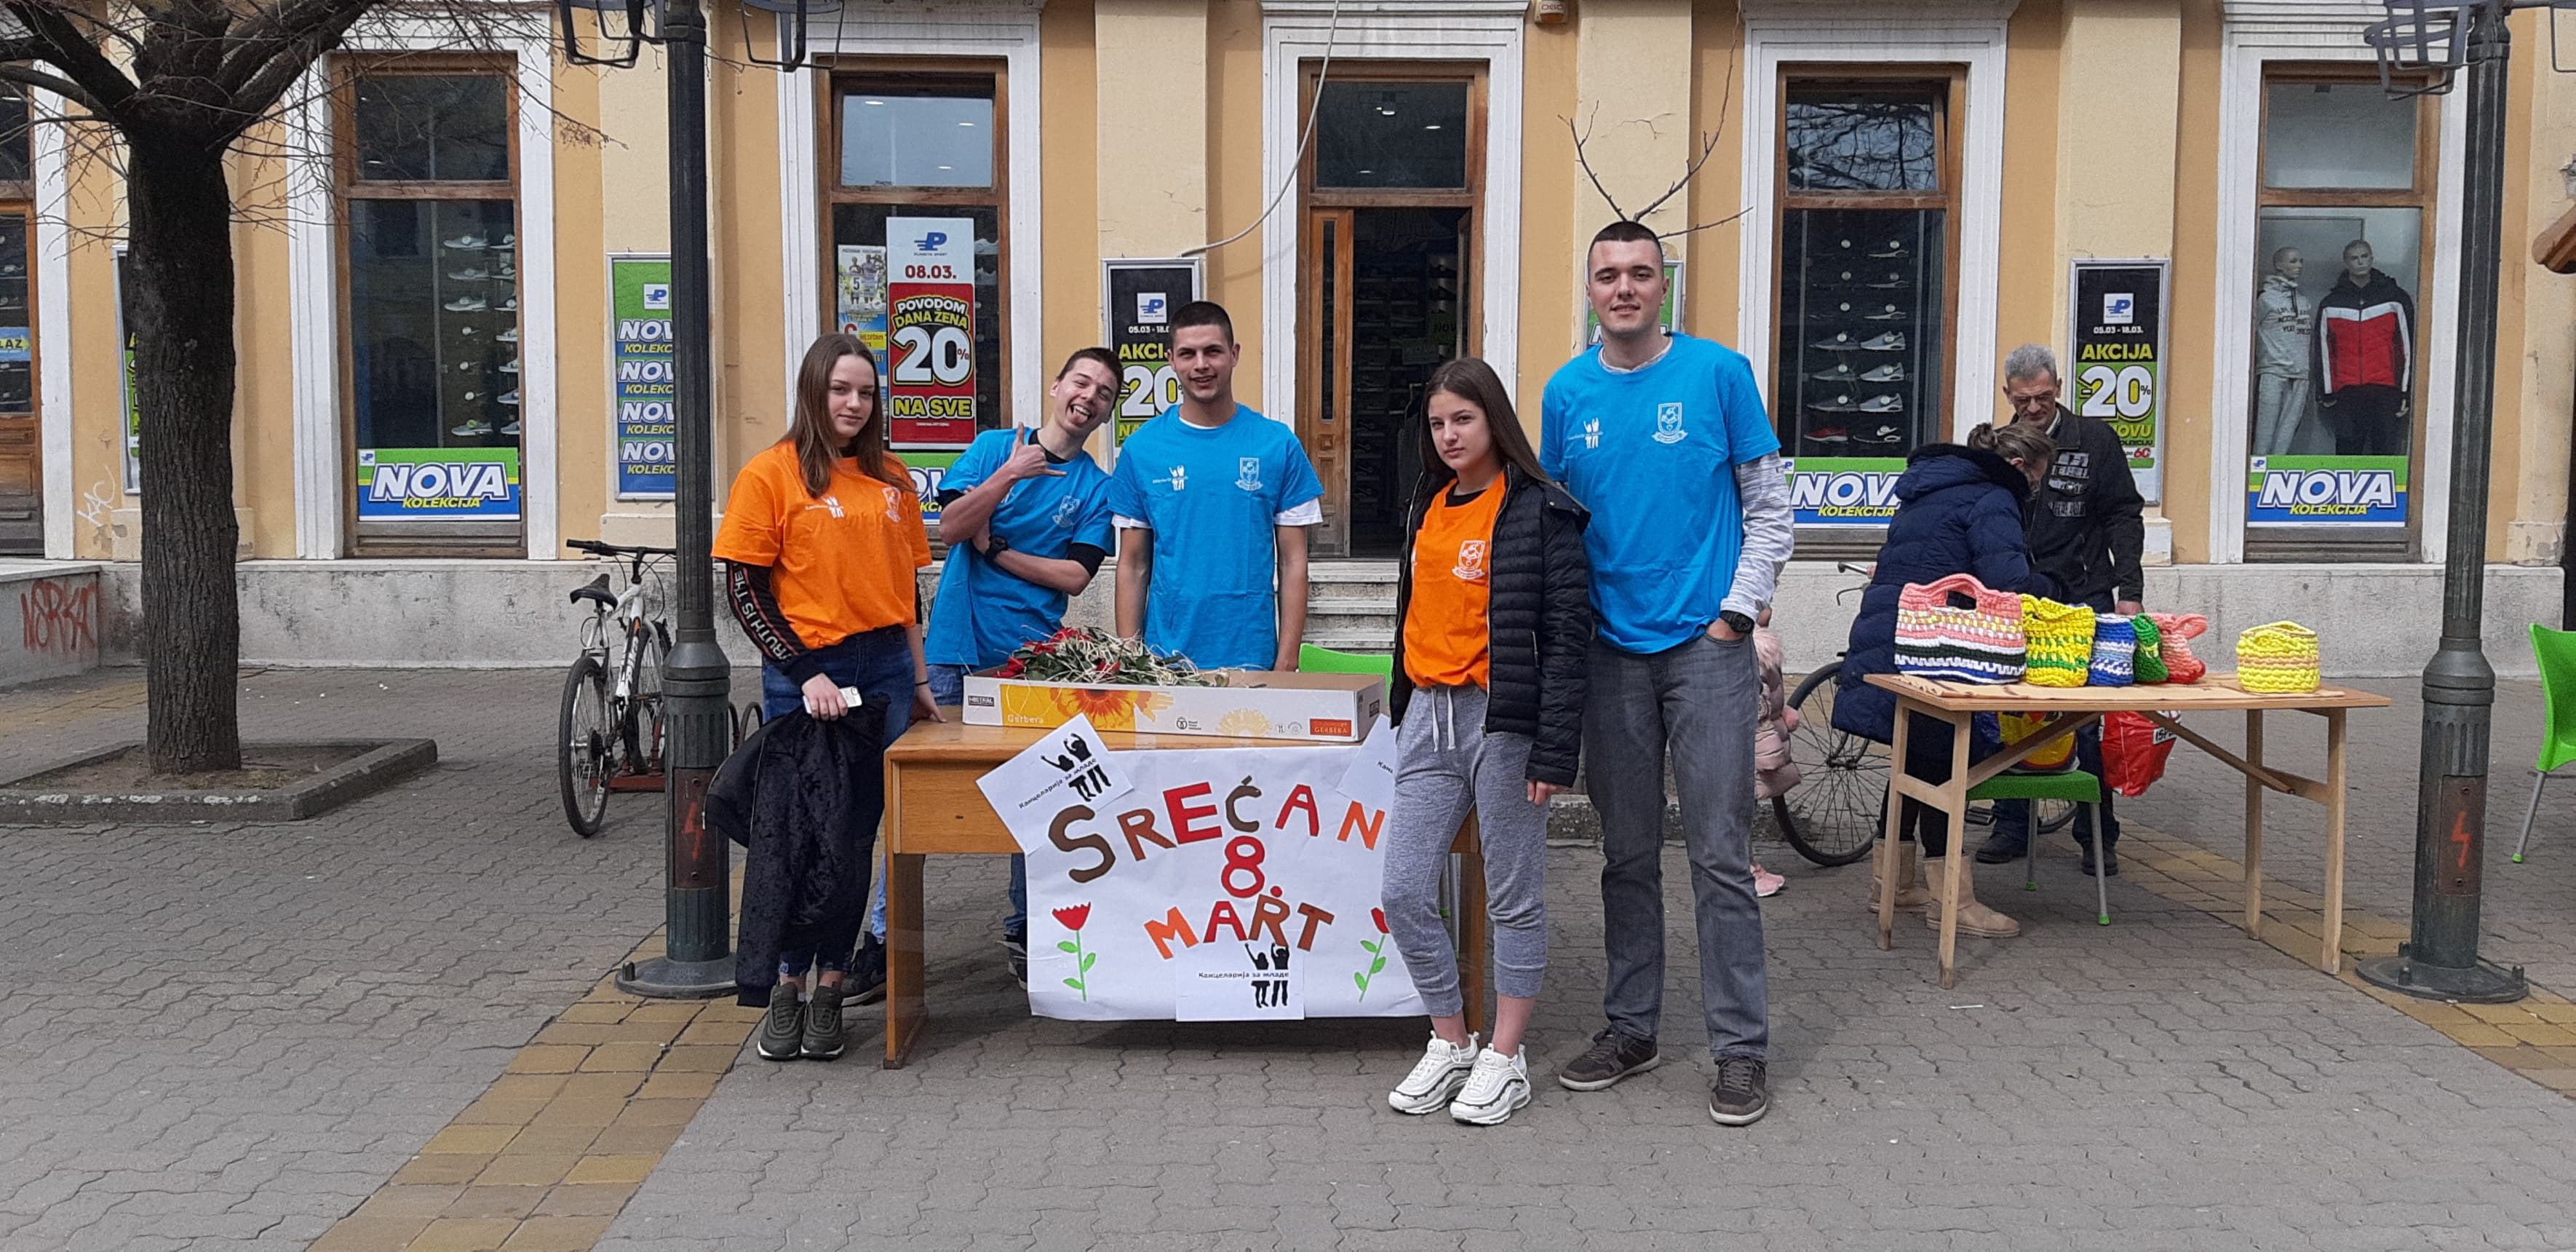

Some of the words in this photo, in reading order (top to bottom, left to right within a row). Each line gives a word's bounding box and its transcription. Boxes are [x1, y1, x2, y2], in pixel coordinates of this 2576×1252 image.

[905, 264, 957, 279] 08.03.
[897, 298, 967, 314] POVODOM
[894, 310, 932, 329] DANA
[934, 308, 968, 330] ŽENA
[1432, 322, 1456, 333] NOV
[619, 320, 673, 341] NOV
[625, 344, 673, 353] KOLEKC
[2081, 343, 2153, 360] AKCIJA
[619, 360, 674, 381] NOV
[625, 384, 674, 394] KOLEKC
[620, 400, 675, 423] NOV
[894, 398, 926, 416] NA
[929, 397, 972, 416] SVE
[627, 425, 675, 435] KOLEKC
[2114, 424, 2152, 437] OVU
[621, 440, 675, 463] NOV
[627, 464, 675, 474] KOLEKC
[370, 463, 509, 501] NOVA
[2258, 470, 2396, 507] NOVA
[402, 497, 480, 508] KOLEKCIJA
[2289, 504, 2367, 515] KOLEKCIJA
[1818, 506, 1896, 517] KOLEKCIJA
[734, 570, 748, 602] THE
[742, 602, 757, 619] IS
[1048, 775, 1385, 883] SREĆAN
[1143, 894, 1335, 960] MART
[1198, 971, 1249, 979] Канцеларија
